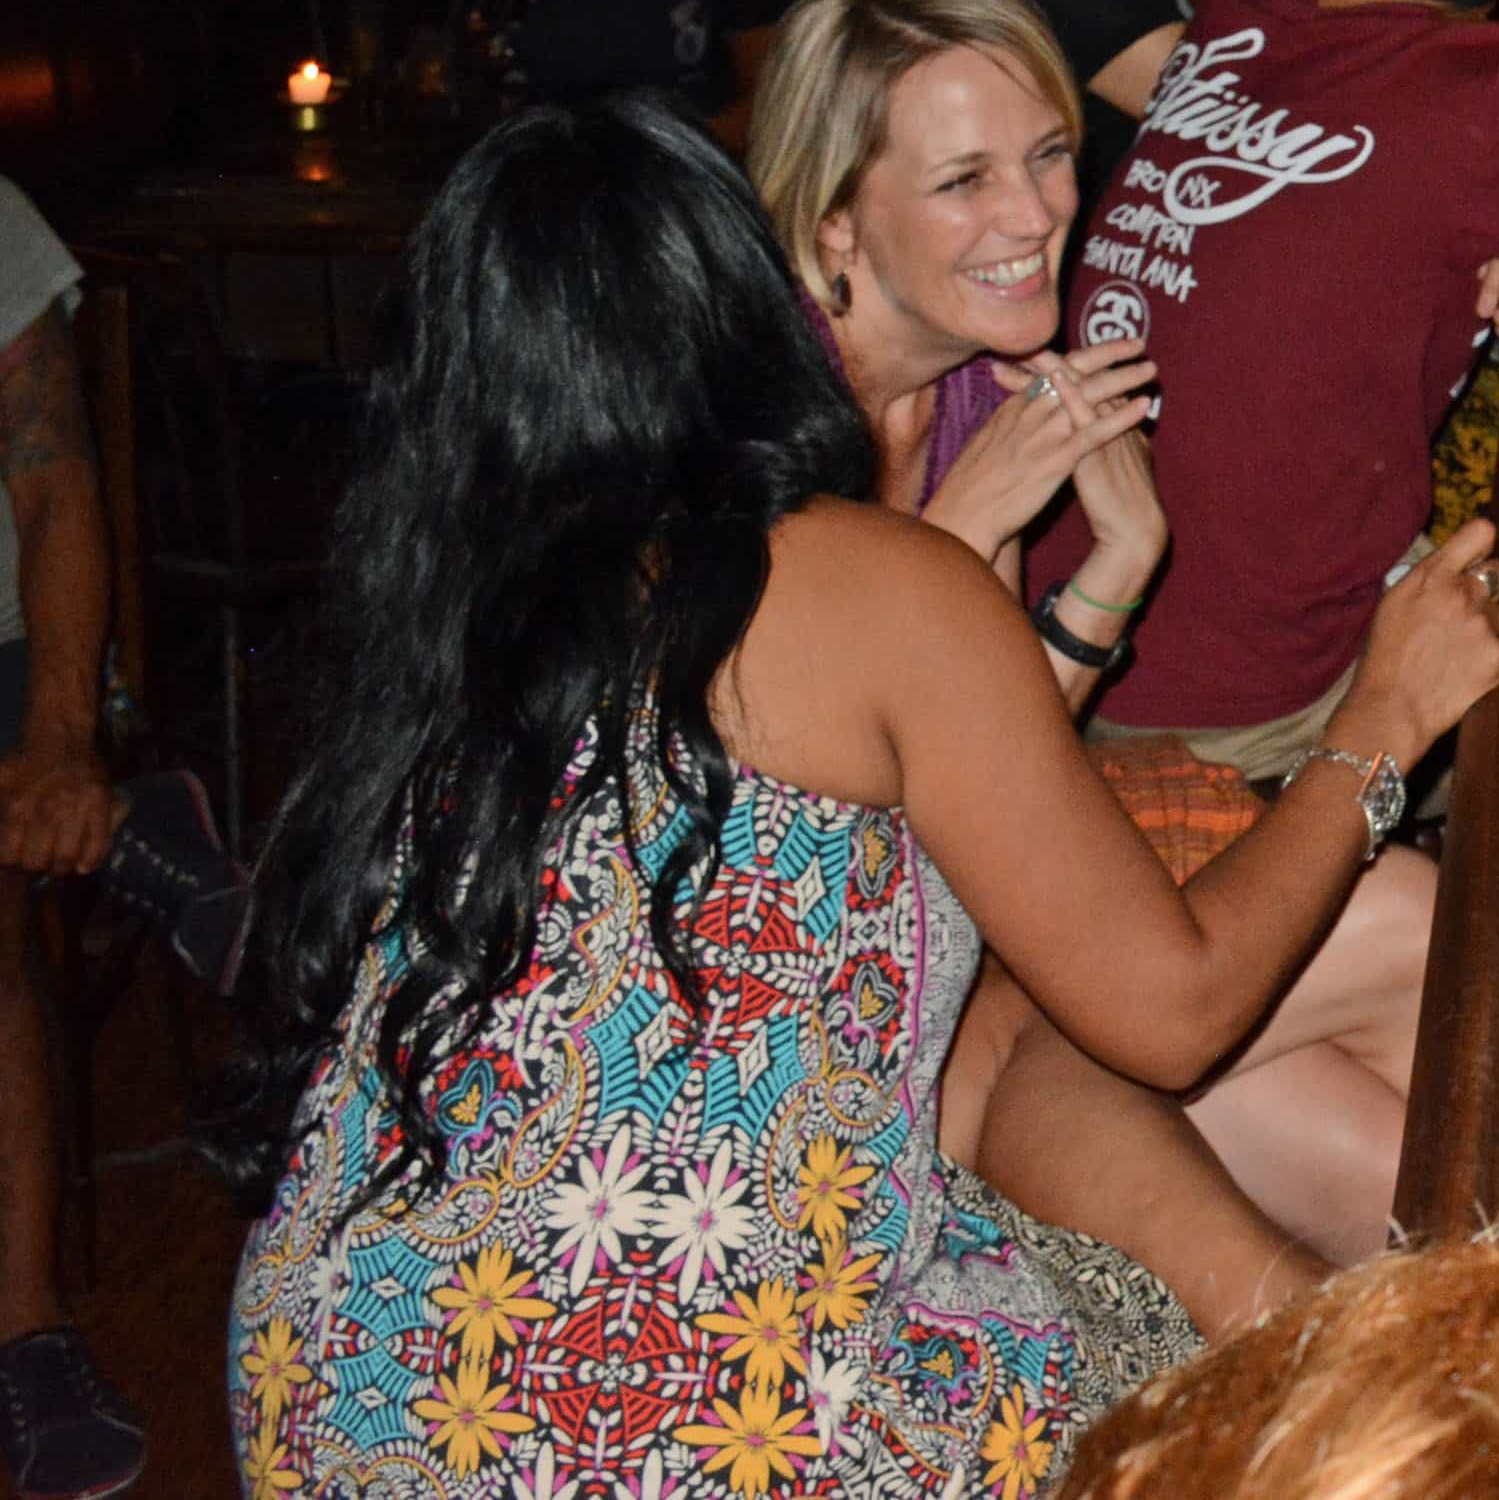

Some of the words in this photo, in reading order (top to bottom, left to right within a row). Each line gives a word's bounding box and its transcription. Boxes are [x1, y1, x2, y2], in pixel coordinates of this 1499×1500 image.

[1104, 202, 1197, 256] COMPTON
[1082, 234, 1145, 282] SANTA
[1144, 256, 1199, 303] ANA
